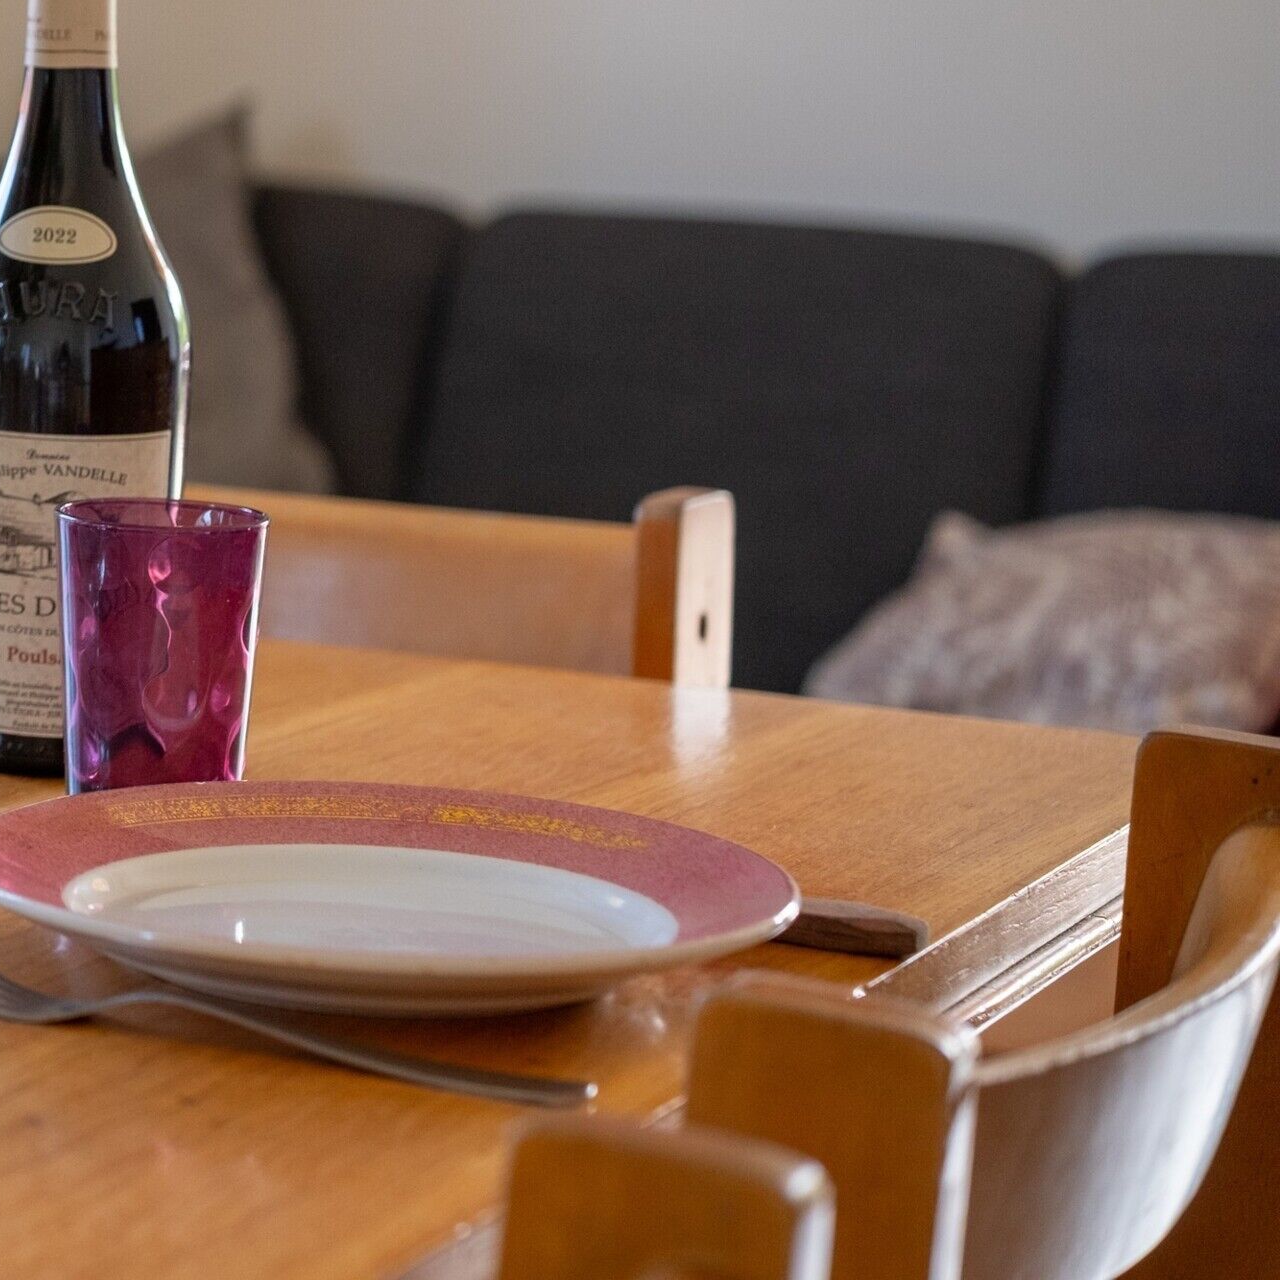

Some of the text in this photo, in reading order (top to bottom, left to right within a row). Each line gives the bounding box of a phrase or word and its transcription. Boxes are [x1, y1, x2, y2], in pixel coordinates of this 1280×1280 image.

[32, 227, 77, 244] 2022
[43, 463, 128, 486] VANDELLE
[7, 646, 61, 665] Pouls
